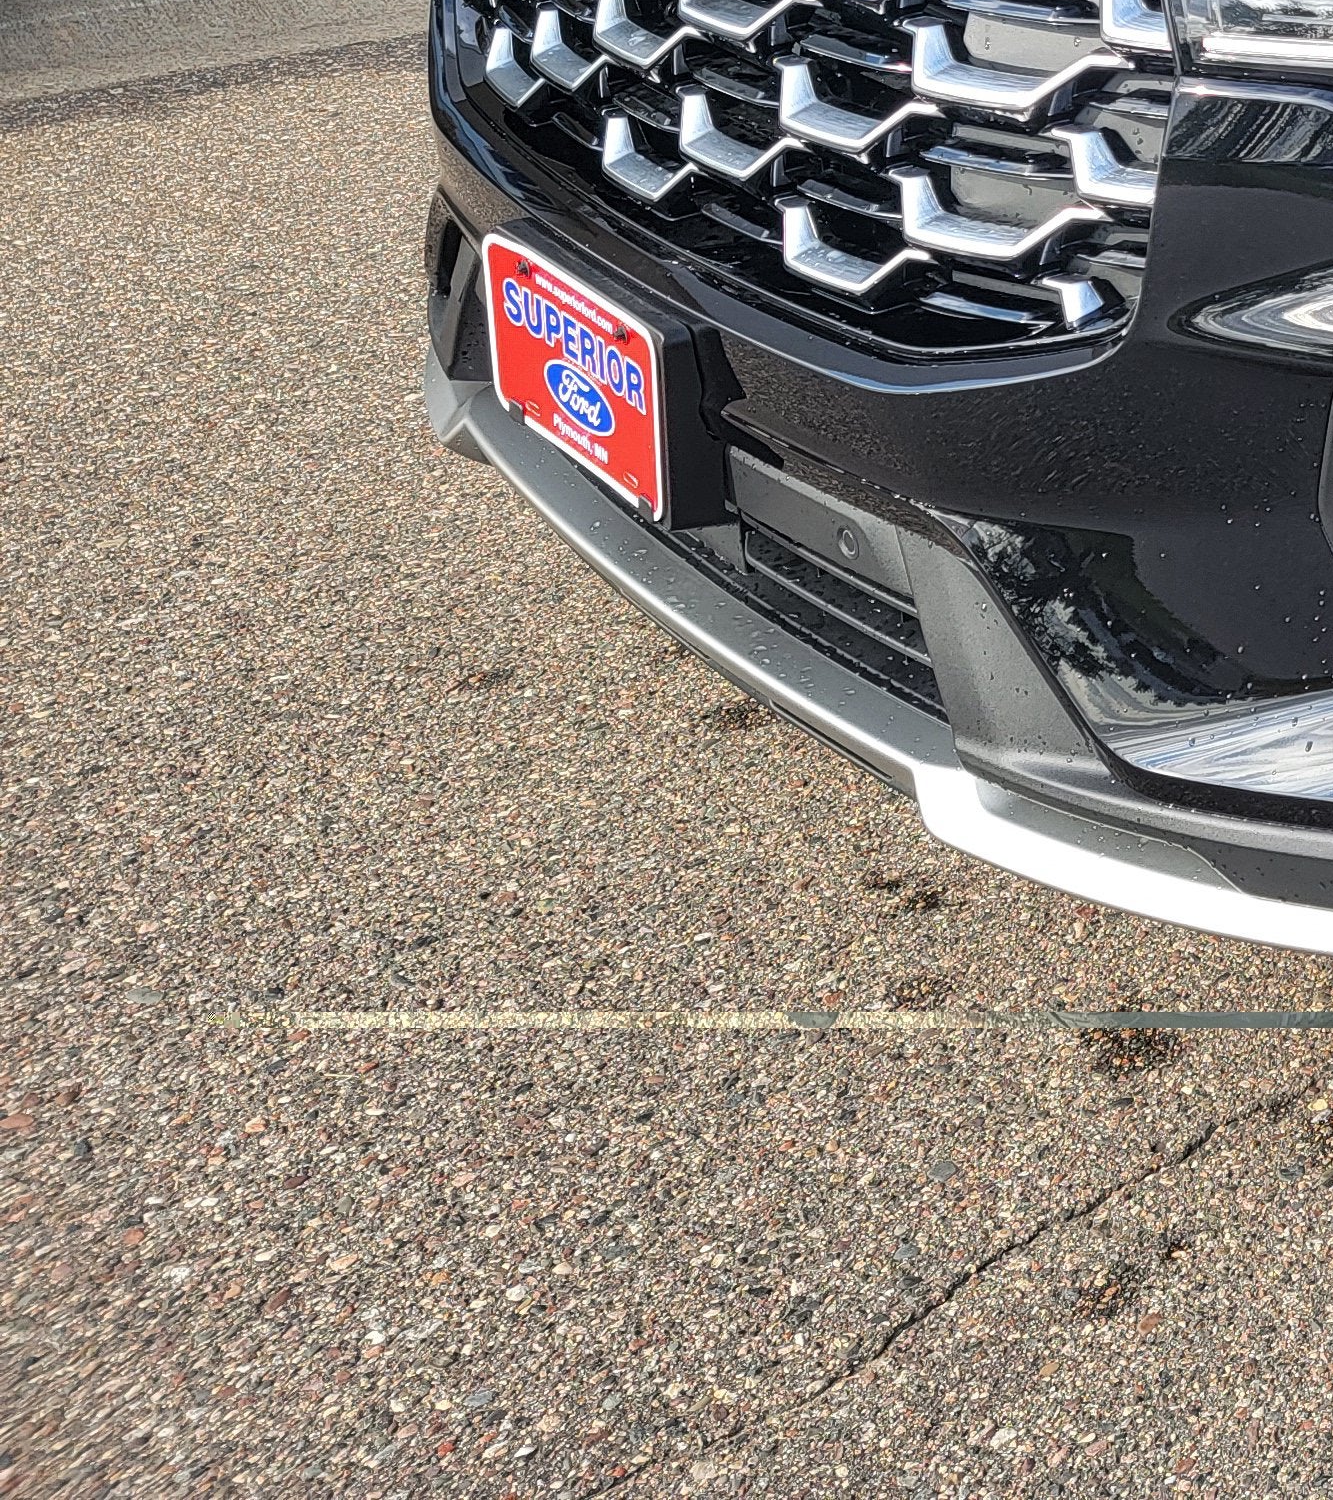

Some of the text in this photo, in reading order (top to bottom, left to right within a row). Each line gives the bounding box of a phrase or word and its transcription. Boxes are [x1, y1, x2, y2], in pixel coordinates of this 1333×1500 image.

[534, 273, 613, 334] www.superiorford.com
[502, 277, 647, 416] SUPERIOR
[558, 368, 601, 427] Ford
[553, 412, 609, 465] Plymouth, MN
